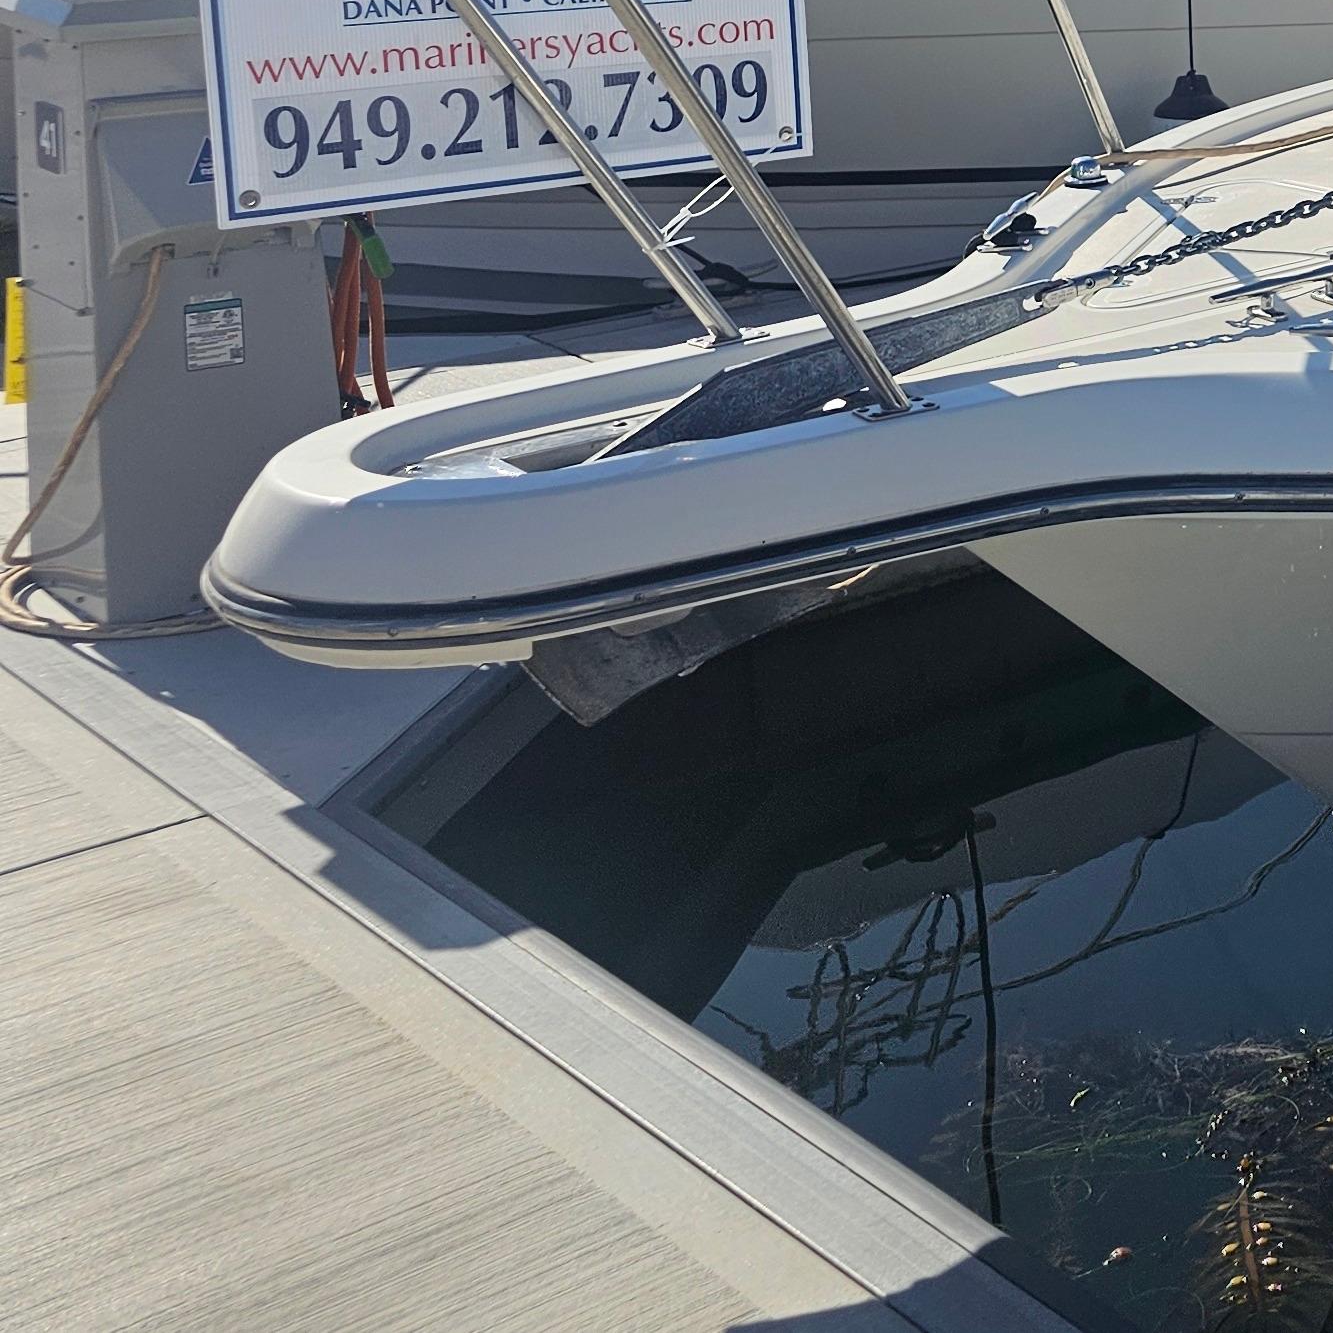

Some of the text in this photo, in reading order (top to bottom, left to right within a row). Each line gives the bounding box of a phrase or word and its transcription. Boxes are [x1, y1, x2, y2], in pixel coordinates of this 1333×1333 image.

[246, 17, 775, 84] www.mariersyacs.com
[40, 120, 56, 157] 41
[263, 60, 768, 178] 949.212.7309
